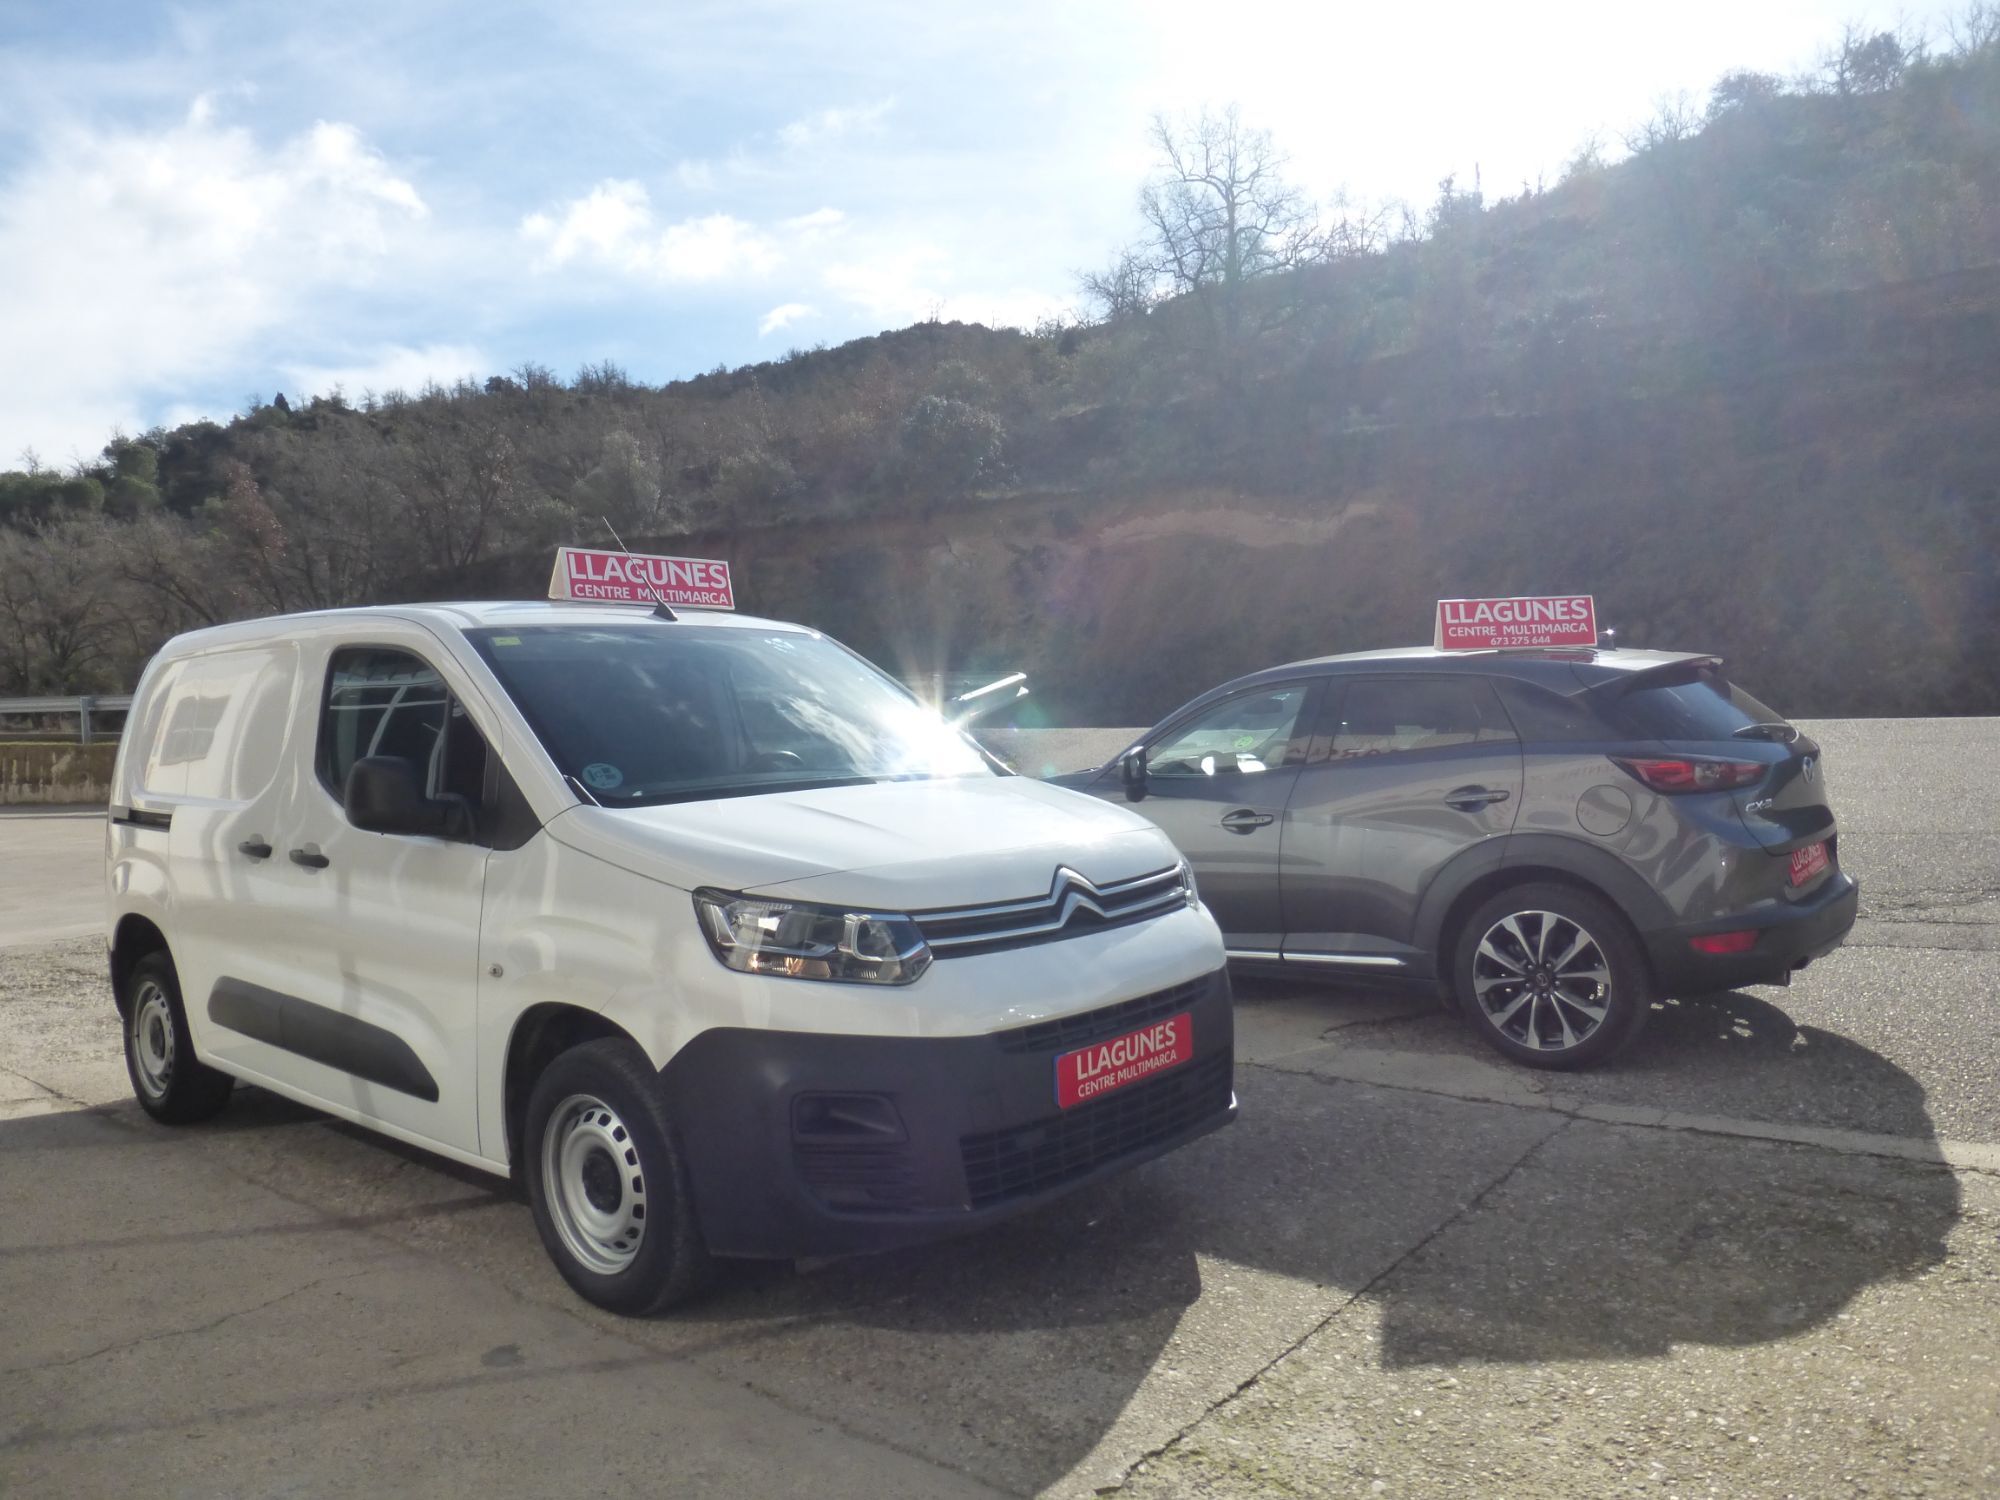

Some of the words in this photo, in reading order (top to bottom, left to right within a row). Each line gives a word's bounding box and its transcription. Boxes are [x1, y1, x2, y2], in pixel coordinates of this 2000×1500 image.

[568, 553, 727, 589] LLAGUNES
[574, 583, 631, 599] CENTRE
[1444, 599, 1589, 624] LLAGUNES
[1448, 626, 1497, 637] CENTRE
[1502, 622, 1588, 635] MULTIMARCA
[1490, 637, 1509, 646] 673
[1511, 636, 1530, 645] 275
[1531, 635, 1550, 644] 644
[1076, 1021, 1176, 1081] LLAGUNES
[1078, 1072, 1116, 1098] CENTRE
[1117, 1049, 1177, 1083] MULTIMARCA
